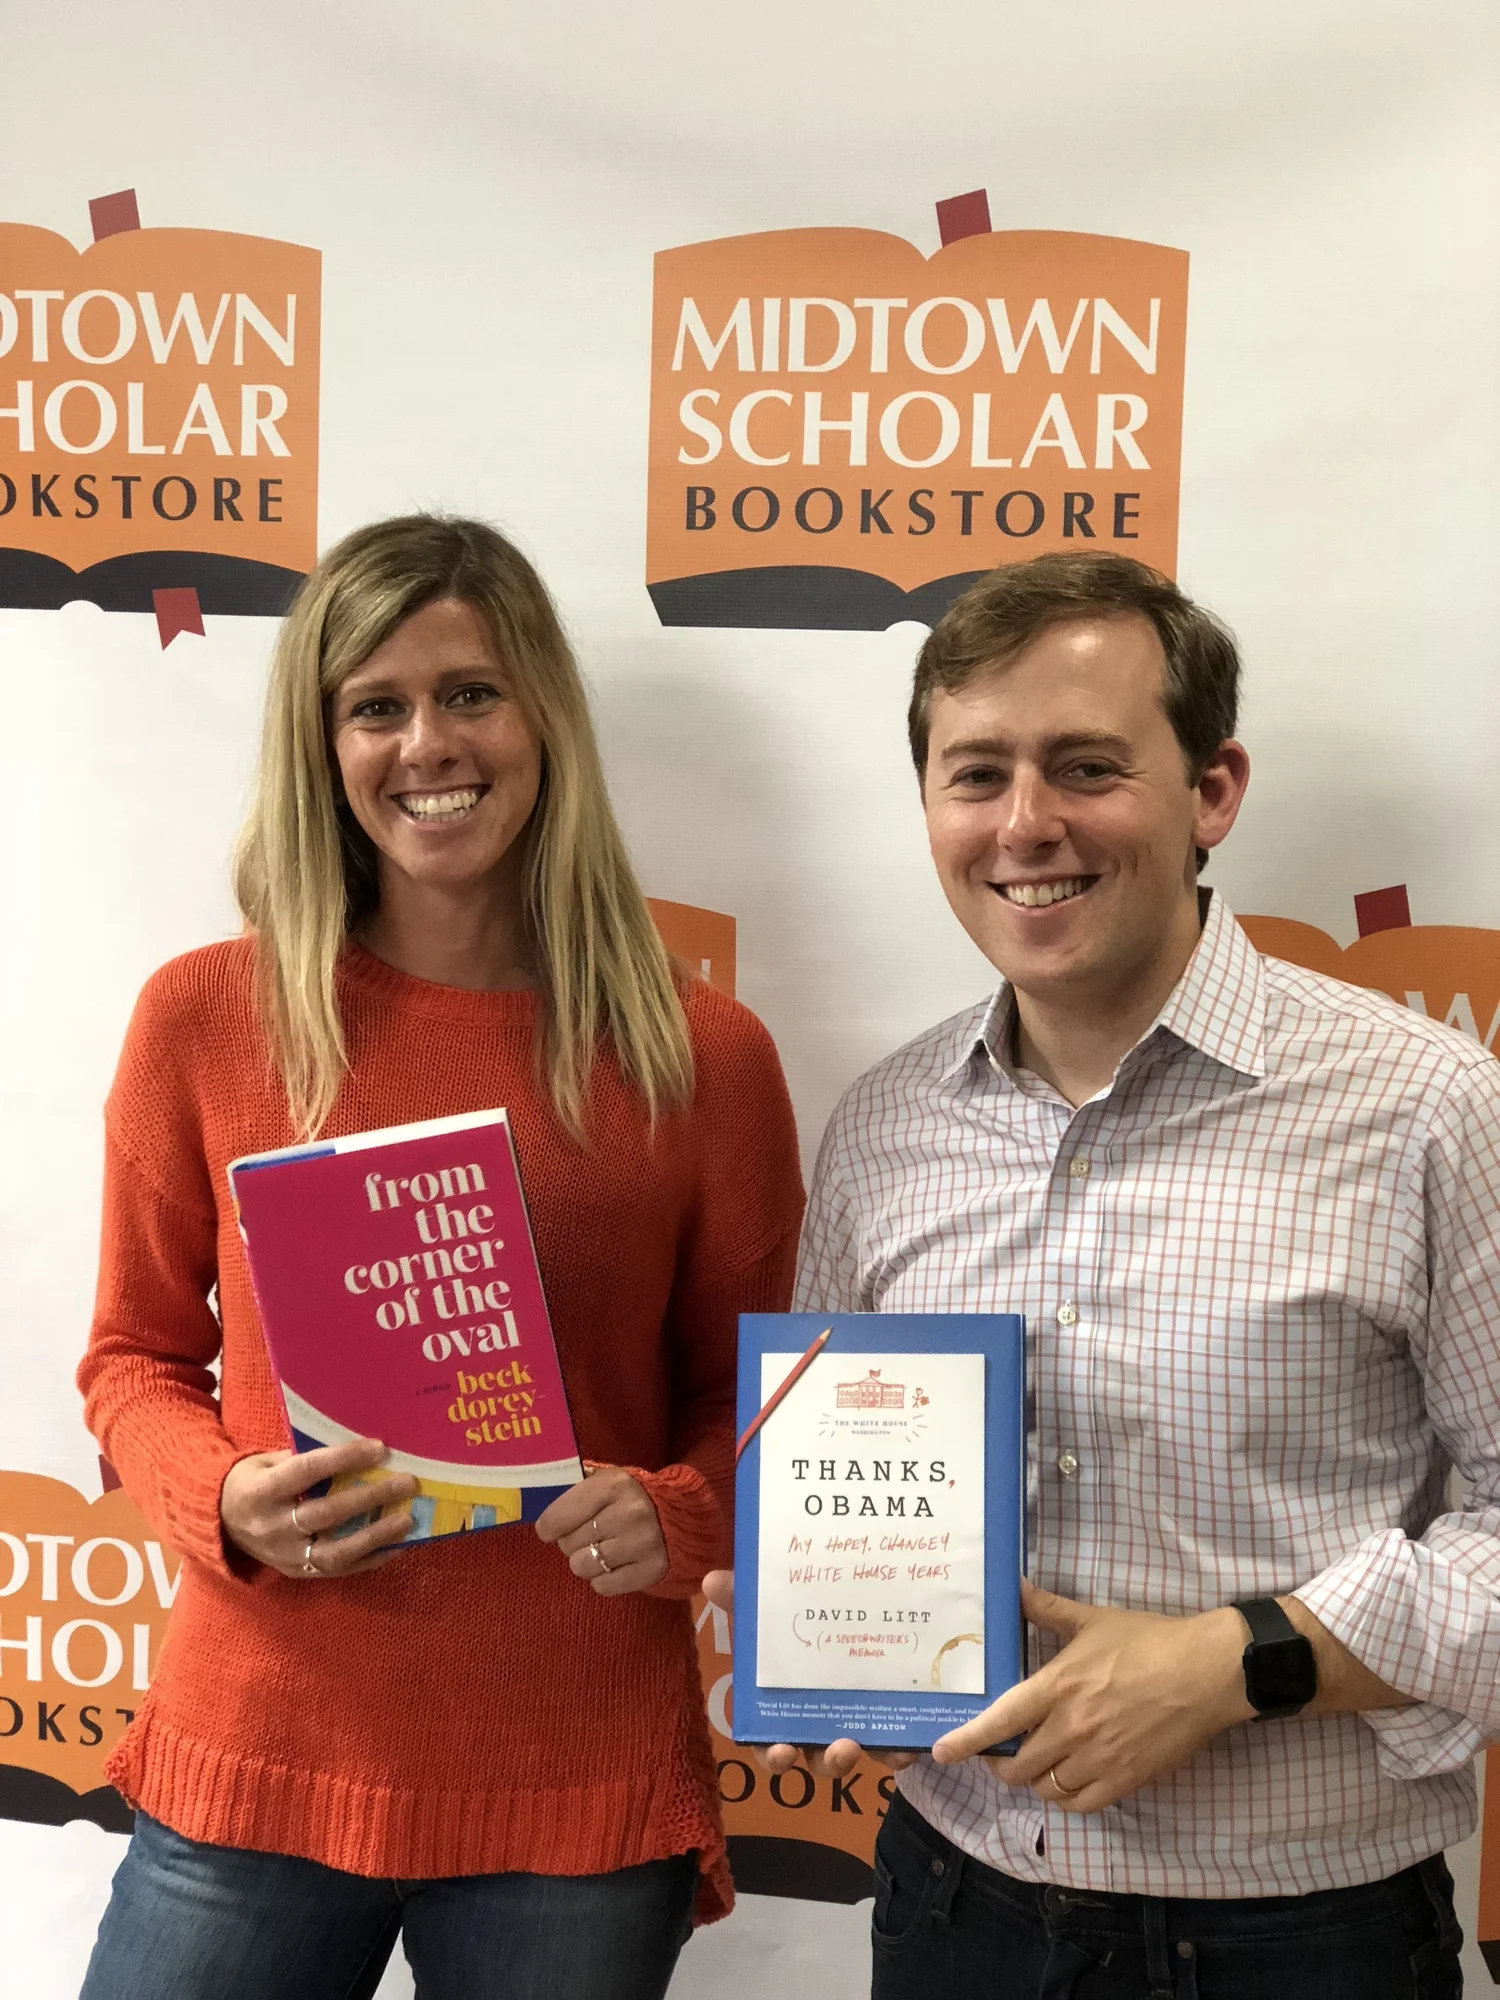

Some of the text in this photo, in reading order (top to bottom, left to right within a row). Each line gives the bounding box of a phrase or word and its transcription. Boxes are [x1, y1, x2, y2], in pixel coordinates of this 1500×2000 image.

[0, 289, 297, 366] TOWN
[671, 296, 1161, 375] MIDTOWN
[678, 388, 1151, 470] SCHOLAR
[685, 486, 1141, 540] BOOKSTORE
[364, 1163, 489, 1212] from
[414, 1203, 495, 1244] the
[344, 1239, 505, 1295] corner
[376, 1279, 512, 1330] of the
[422, 1310, 520, 1362] oval
[456, 1361, 533, 1395] beck
[465, 1413, 542, 1447] stein
[791, 1460, 956, 1489] THANKS,
[804, 1495, 934, 1517] OBAMA
[788, 1533, 812, 1556] MY
[879, 1532, 950, 1553] CHANGEY
[789, 1562, 952, 1584] WHITE HOUSE YEARS
[805, 1609, 931, 1622] DAVID LITT
[820, 1702, 831, 1710] the
